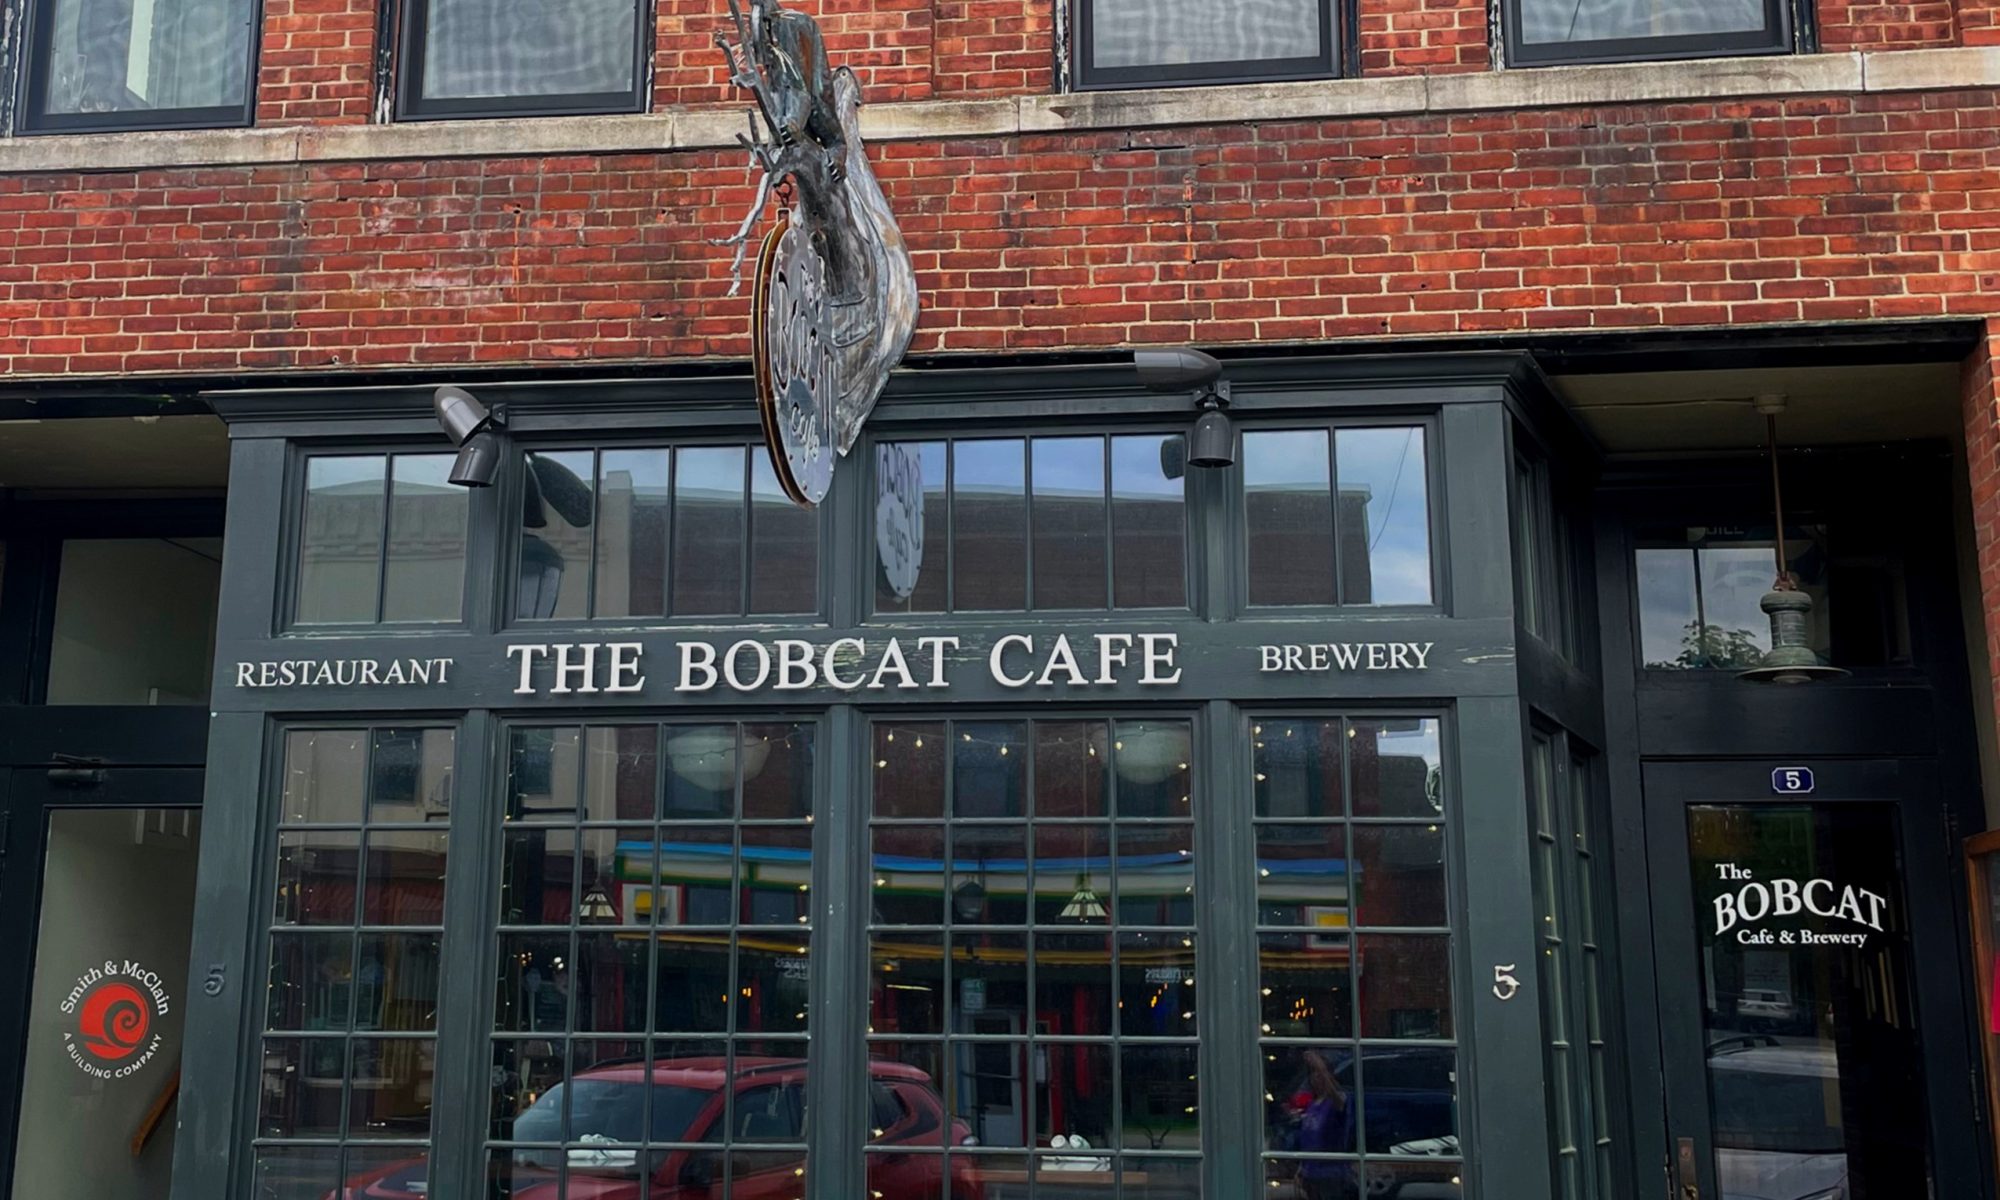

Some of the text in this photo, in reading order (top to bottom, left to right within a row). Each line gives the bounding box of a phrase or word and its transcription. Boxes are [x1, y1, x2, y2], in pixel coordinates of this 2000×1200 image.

[236, 658, 453, 687] RESTAURANT
[507, 633, 1182, 693] THE BOBCAT CAFE
[1260, 642, 1434, 671] BREWERY
[1786, 771, 1801, 789] 5
[1715, 863, 1752, 879] The
[1713, 878, 1886, 935] BOBCAT
[1779, 930, 1796, 944] &
[1800, 929, 1867, 948] Brewery
[60, 960, 170, 1016] Smith & McClain
[204, 963, 226, 997] 5
[1493, 964, 1520, 999] 5
[63, 1033, 162, 1079] A BUILDING COMPANY
